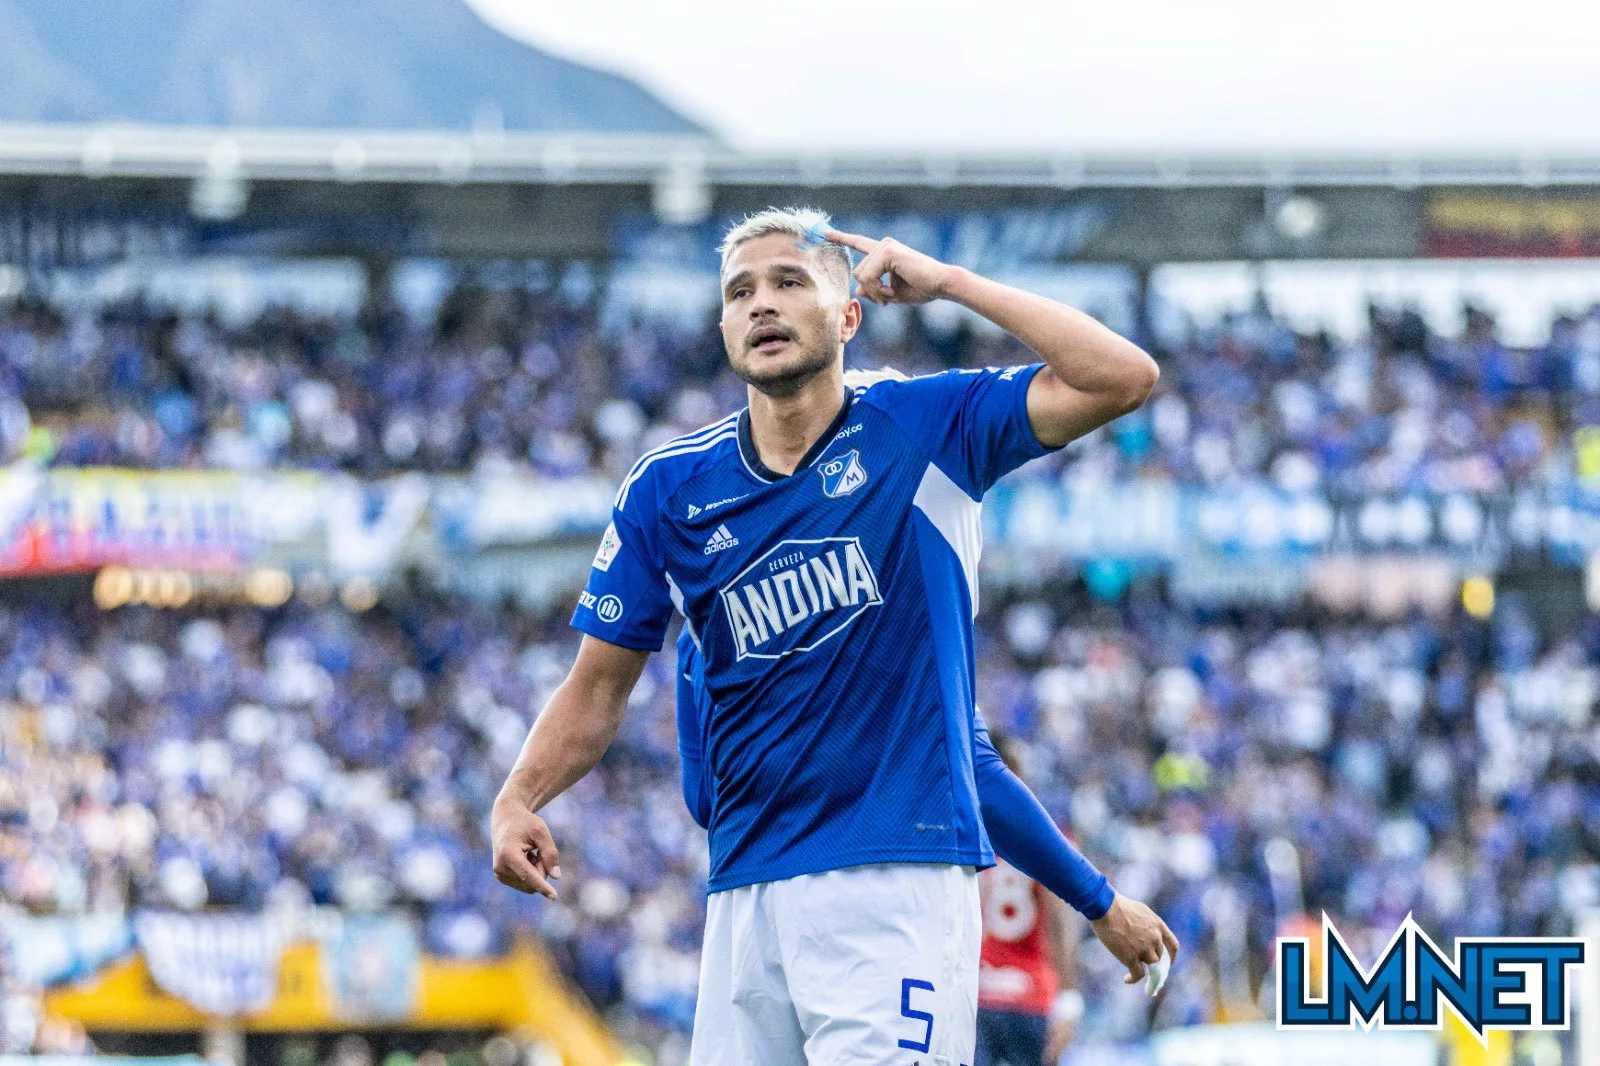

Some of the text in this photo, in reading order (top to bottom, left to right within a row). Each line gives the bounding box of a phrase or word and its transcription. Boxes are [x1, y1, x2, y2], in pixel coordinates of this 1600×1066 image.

[704, 538, 739, 555] adidas
[769, 551, 804, 572] CERVEZA
[726, 543, 877, 655] ANDINA
[898, 977, 935, 1054] 5
